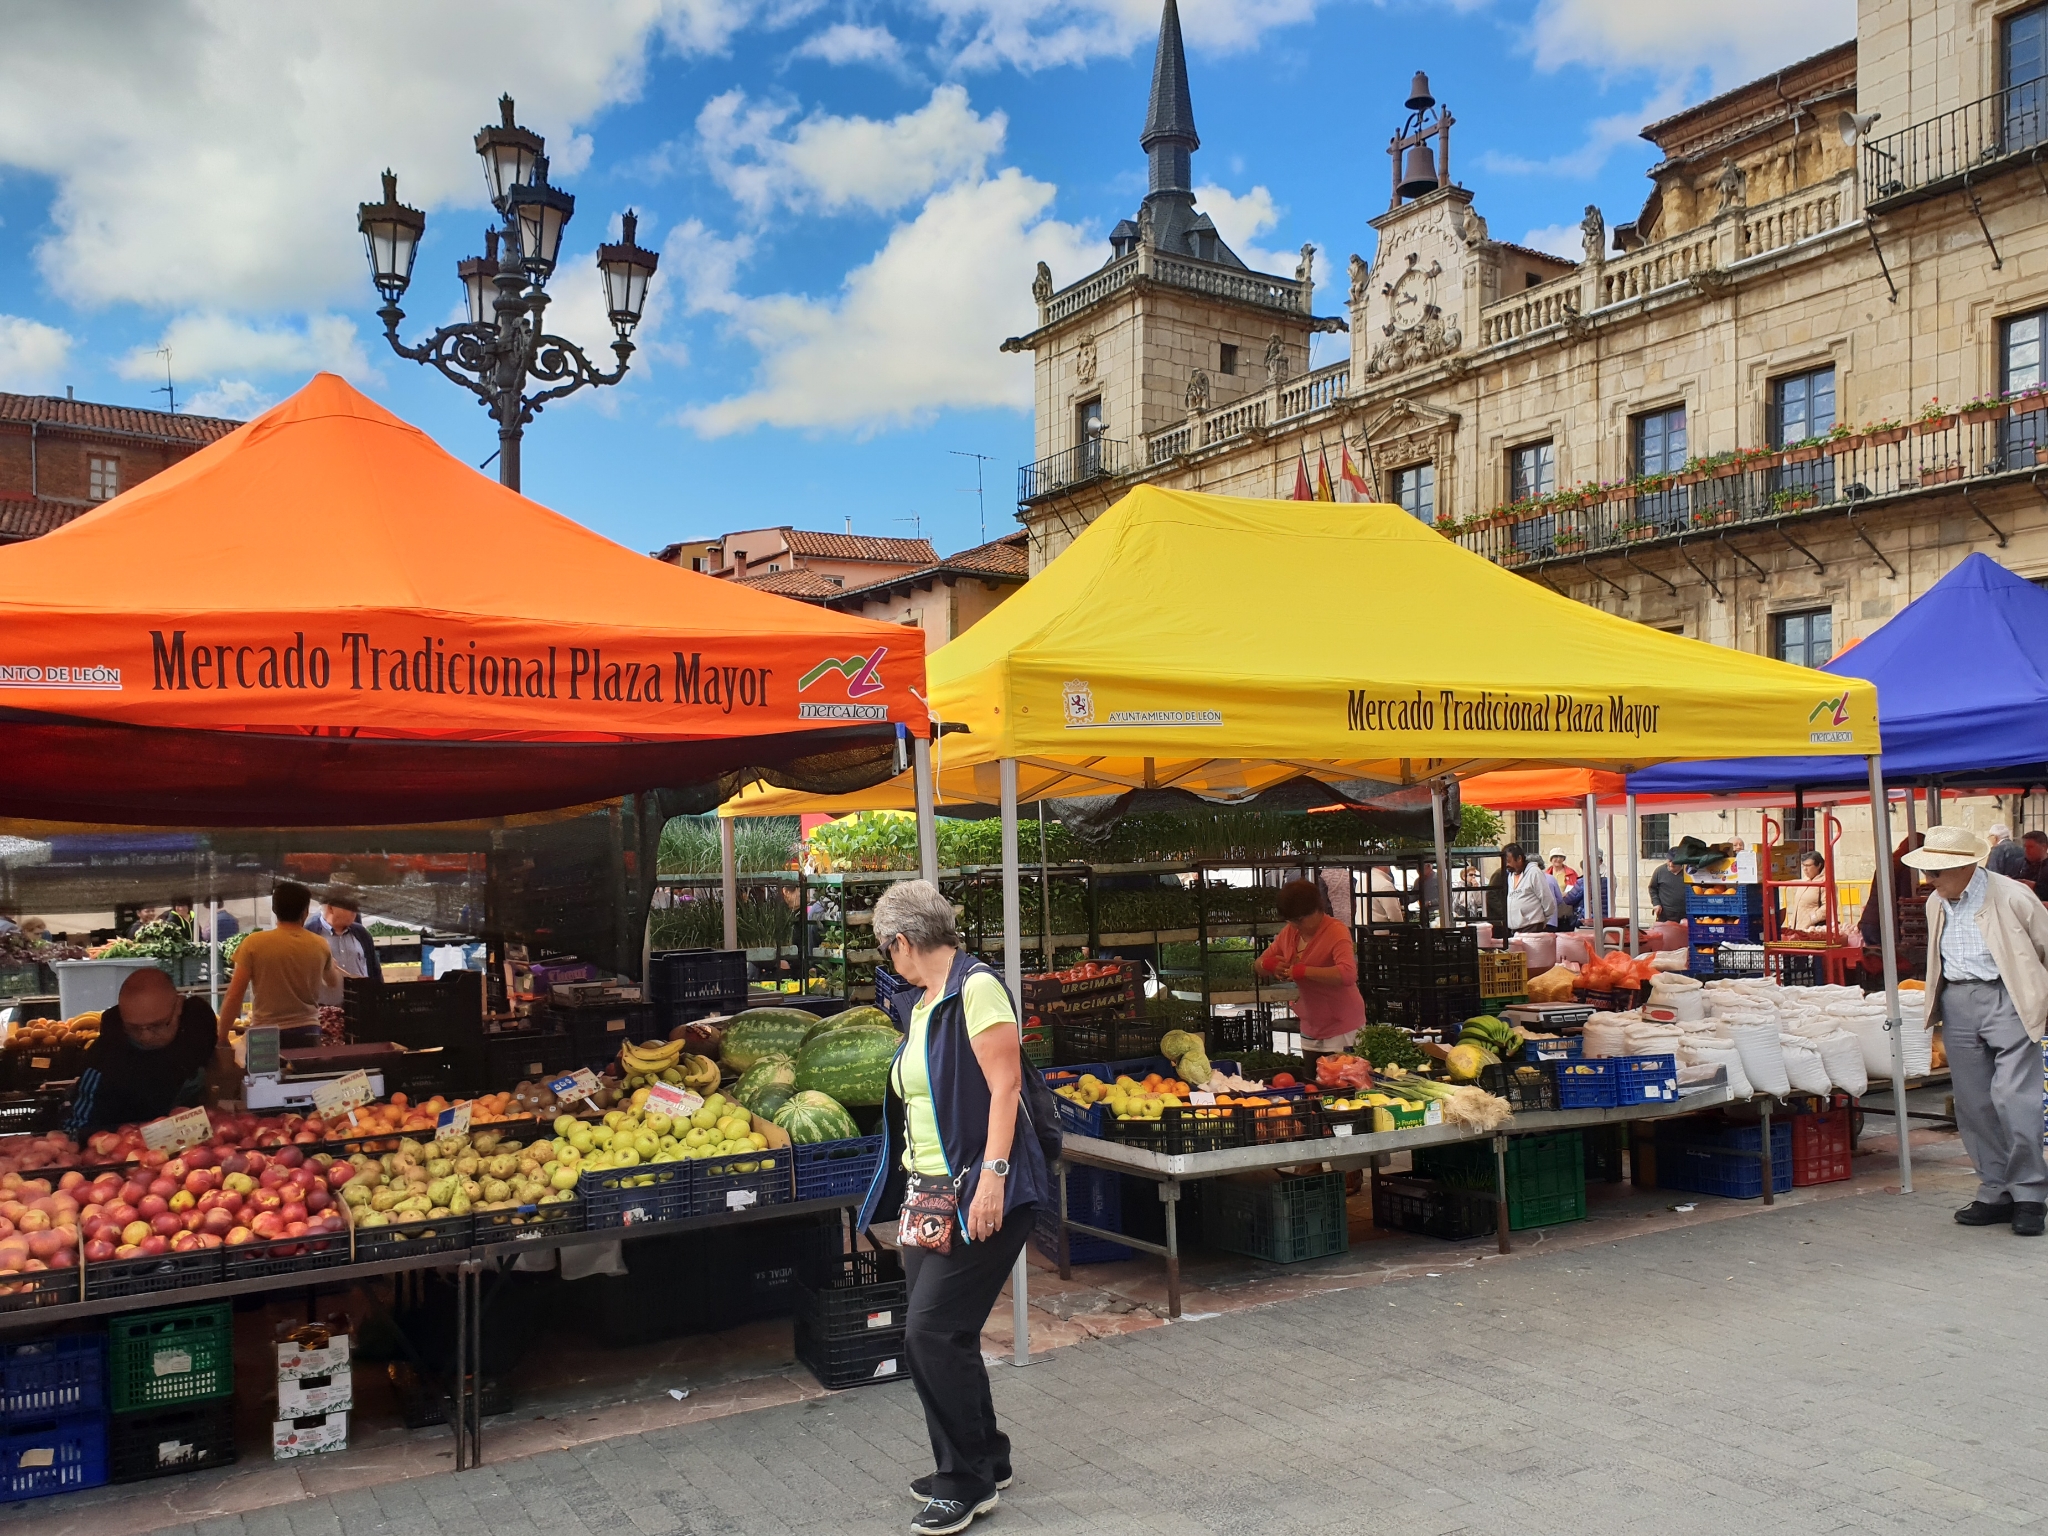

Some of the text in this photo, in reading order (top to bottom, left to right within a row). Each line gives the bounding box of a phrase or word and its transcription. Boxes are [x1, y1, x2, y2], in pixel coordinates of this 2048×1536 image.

[47, 668, 68, 680] DE
[74, 666, 119, 682] LEÓN
[149, 630, 773, 714] Mercado Tradicional Plaza Mayor
[1109, 709, 1221, 722] AYUNTAMIENTO DE LEÓN
[1347, 689, 1660, 739] Mercado Tradicional Plaza Mayor
[1062, 974, 1122, 994] URCIMAR
[1064, 994, 1125, 1013] URCIMAR
[340, 1071, 364, 1086] FRUTAS
[175, 1108, 203, 1123] FRUTAS
